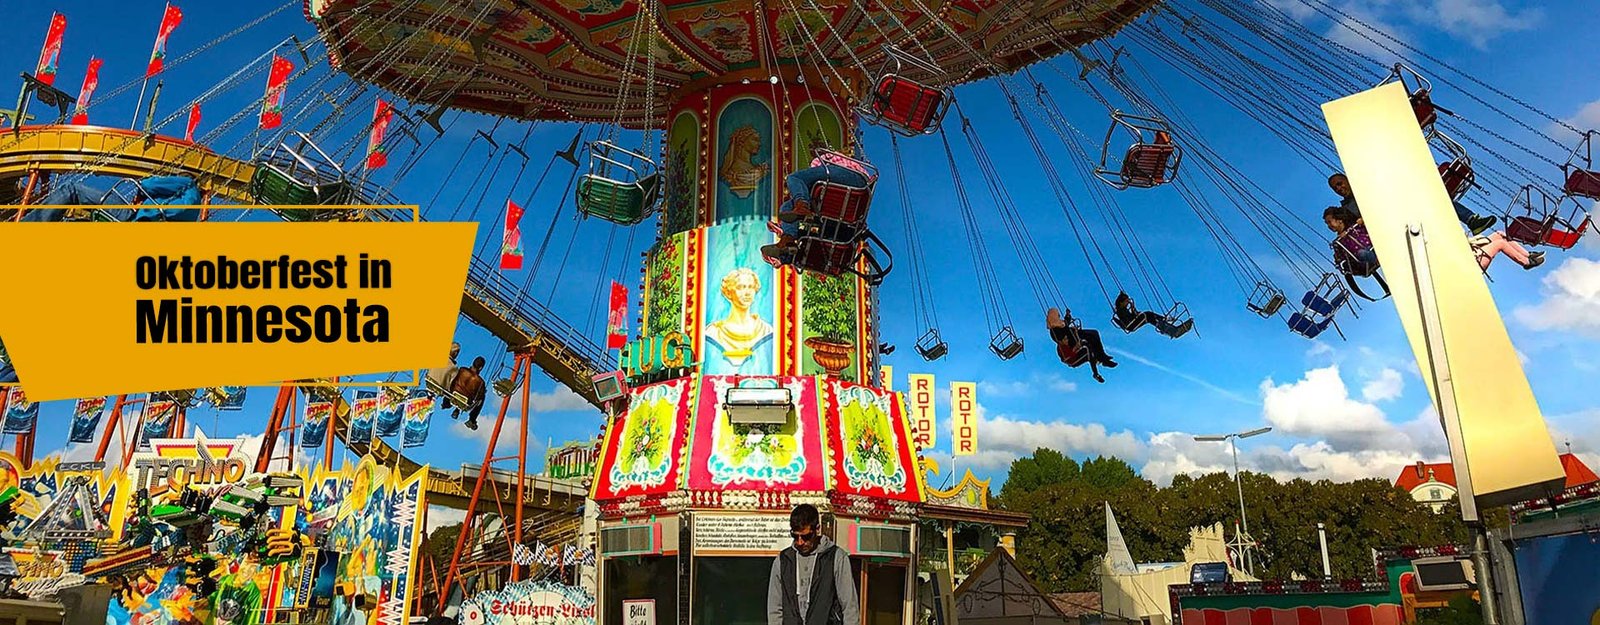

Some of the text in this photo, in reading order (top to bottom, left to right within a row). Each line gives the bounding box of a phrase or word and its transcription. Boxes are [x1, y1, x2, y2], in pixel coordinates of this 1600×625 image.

[916, 378, 930, 446] ROTOR
[959, 387, 972, 452] ROTOR
[135, 458, 246, 497] TECHNO
[630, 604, 647, 619] Bitte
